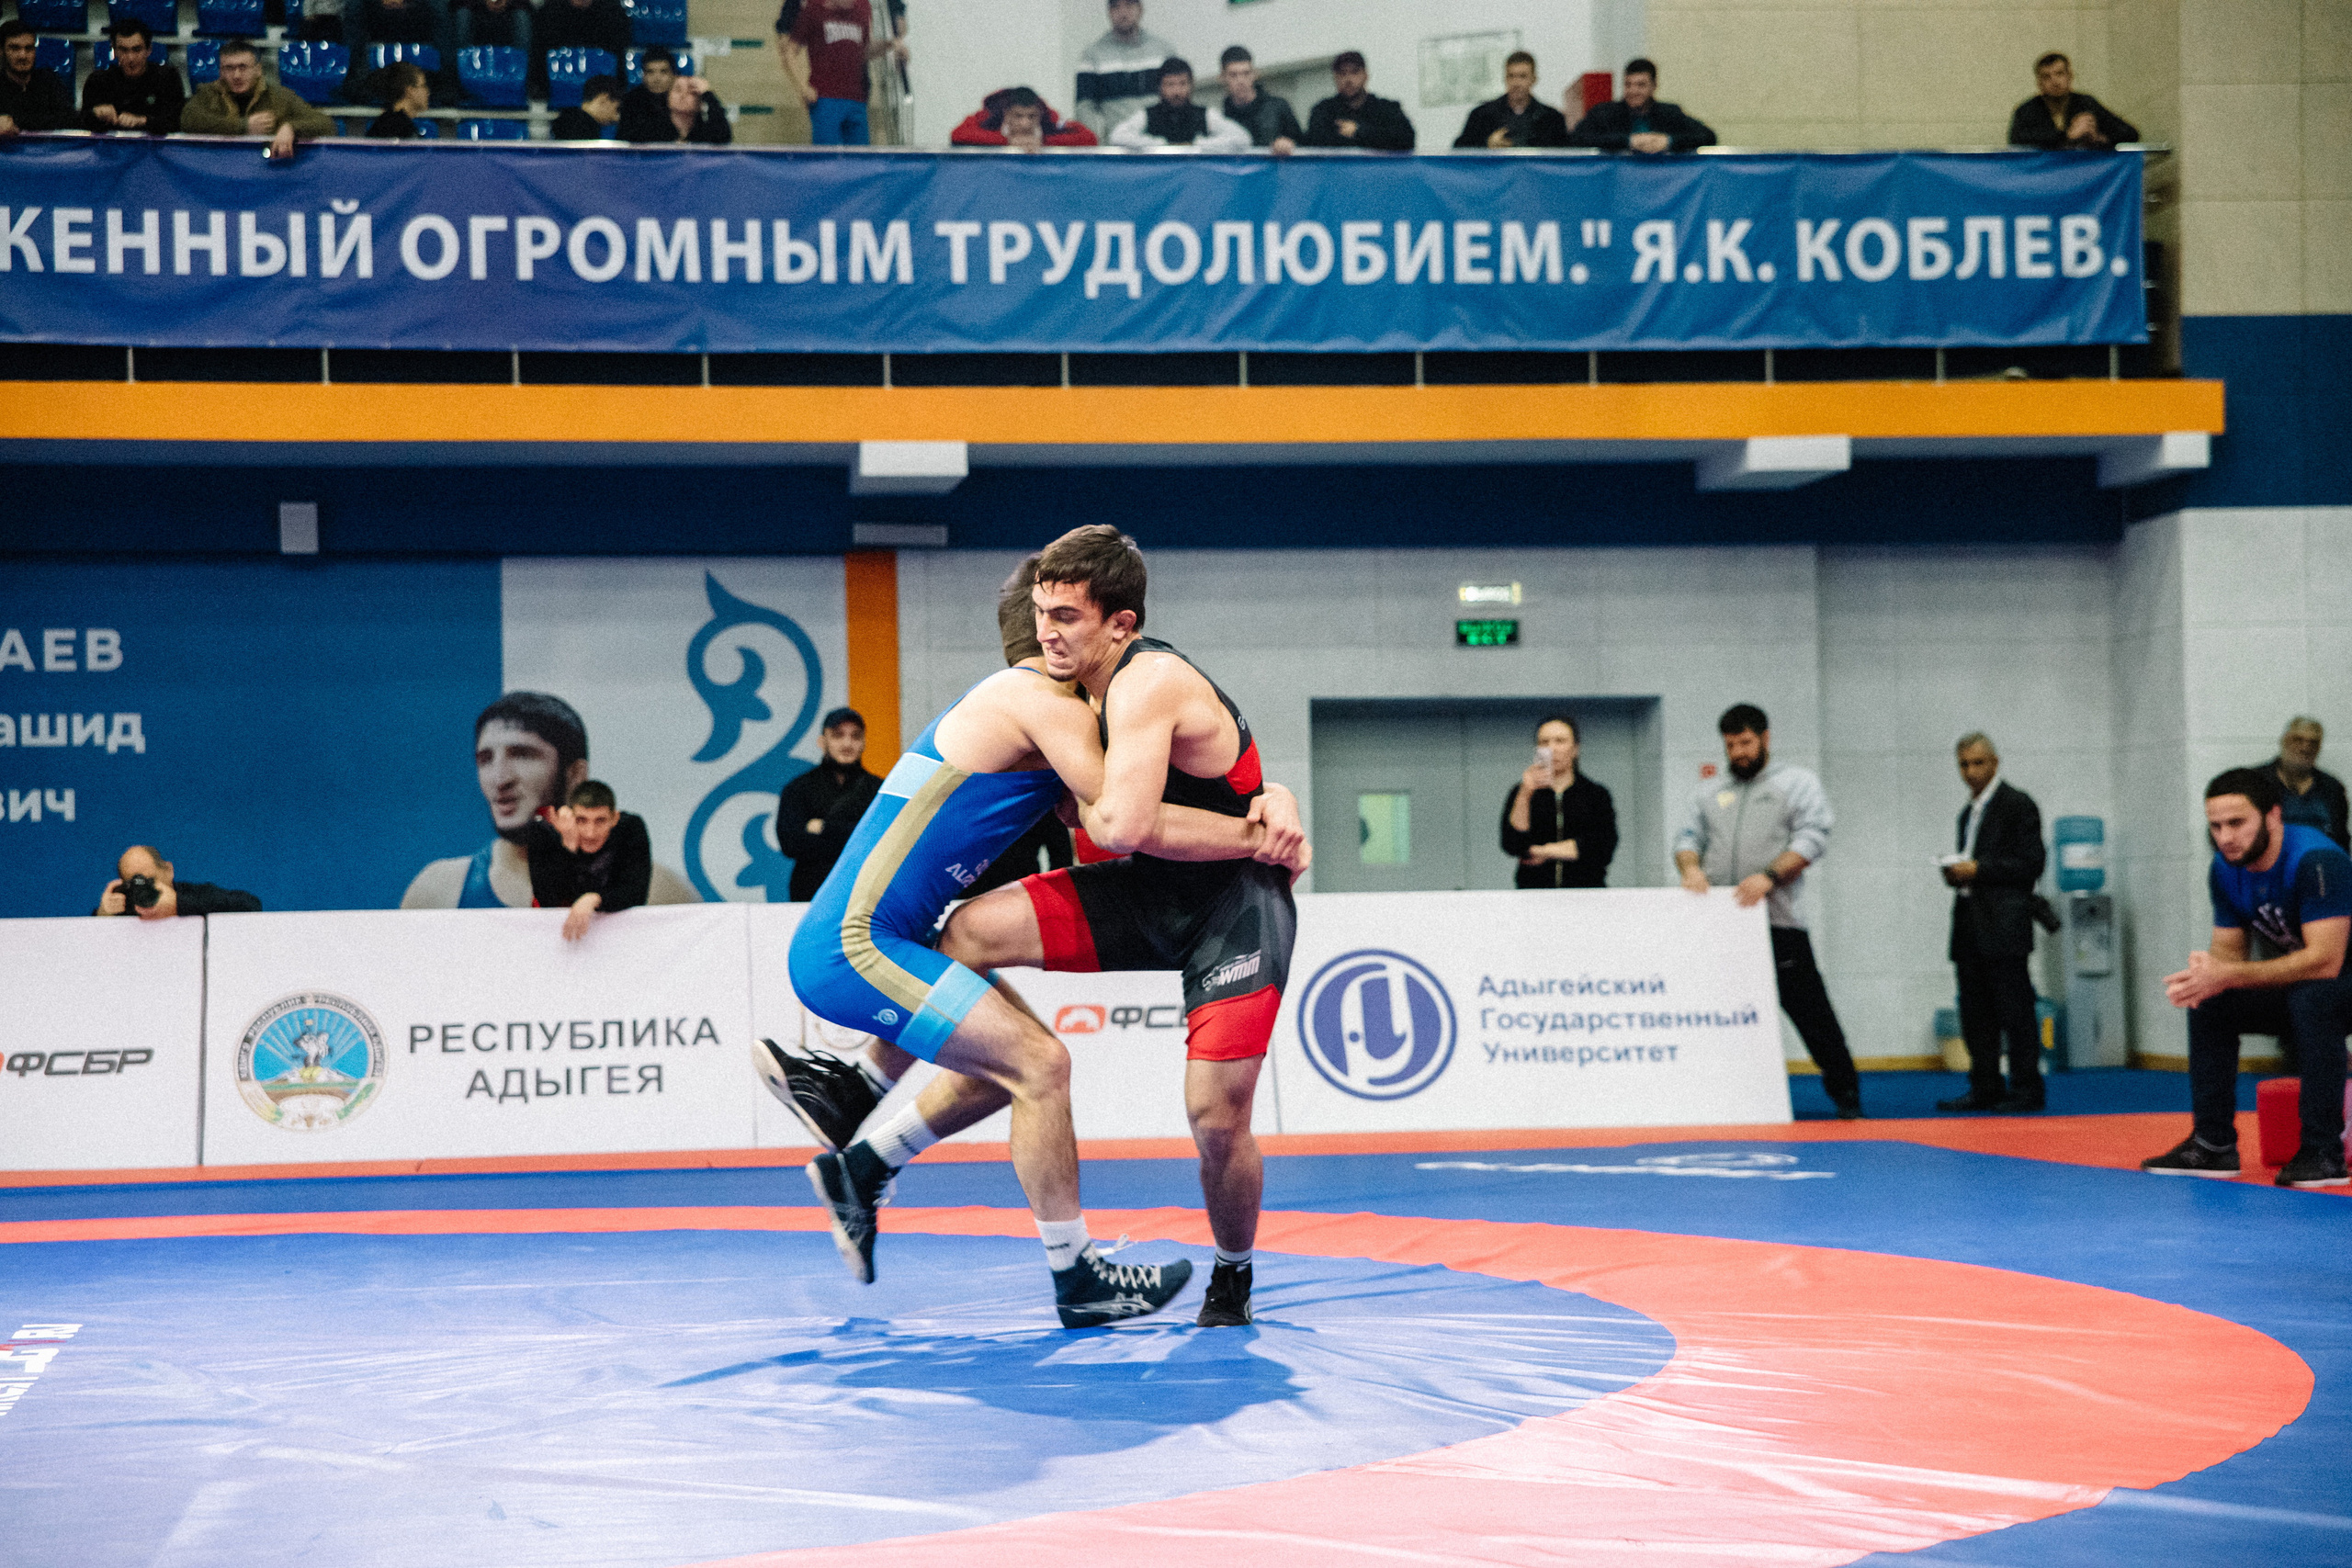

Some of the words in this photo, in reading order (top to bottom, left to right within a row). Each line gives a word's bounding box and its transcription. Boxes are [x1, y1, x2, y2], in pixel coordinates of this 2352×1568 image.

[401, 214, 913, 283] ОГРОМНЫМ
[934, 220, 1611, 299] ТРУДОЛЮБИЕМ."
[1632, 220, 1774, 282] Я.К.
[1797, 215, 2129, 281] КОБЛЕВ.
[1477, 974, 1667, 998] Адыгейский
[1479, 1004, 1759, 1034] Государственный
[408, 1016, 721, 1055] РЕСПУБЛИКА
[6, 1047, 154, 1078] ФСБР
[1482, 1042, 1679, 1067] Университет
[464, 1062, 664, 1105] АДЫГЕЯ
